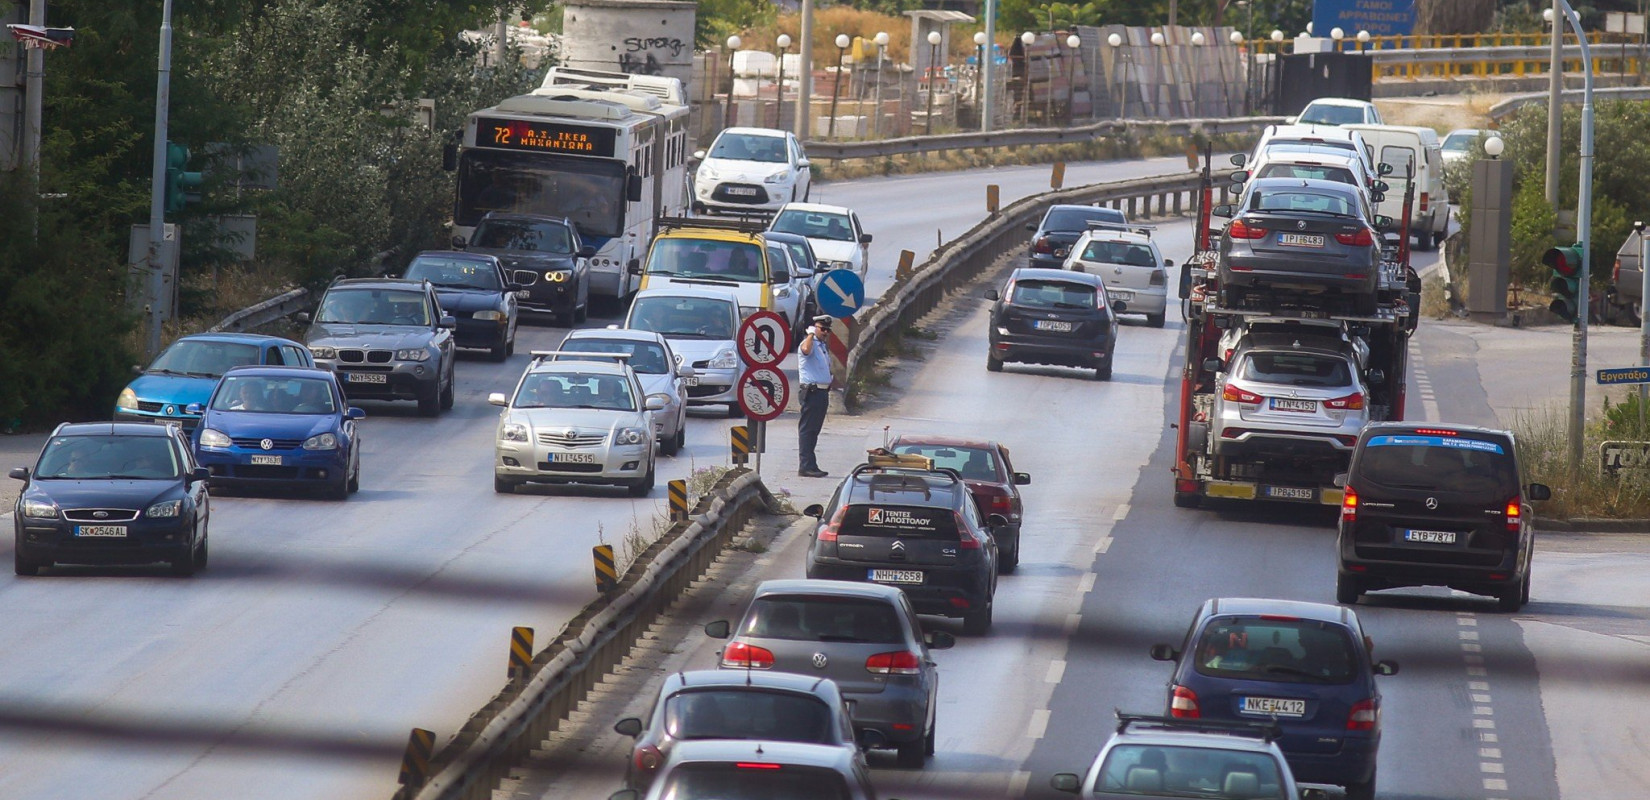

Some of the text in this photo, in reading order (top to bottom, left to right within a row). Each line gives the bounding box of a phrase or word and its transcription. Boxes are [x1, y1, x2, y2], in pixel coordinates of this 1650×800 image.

[494, 127, 511, 144] 72
[520, 139, 593, 151] ΜΗΧΑΝΙΩΝΑ
[1600, 370, 1648, 383] Εργοτάξιο
[885, 510, 911, 518] ΤΕΝΤΕΣ
[885, 516, 931, 526] ΑΠΟΣΤΟΛΟΥ
